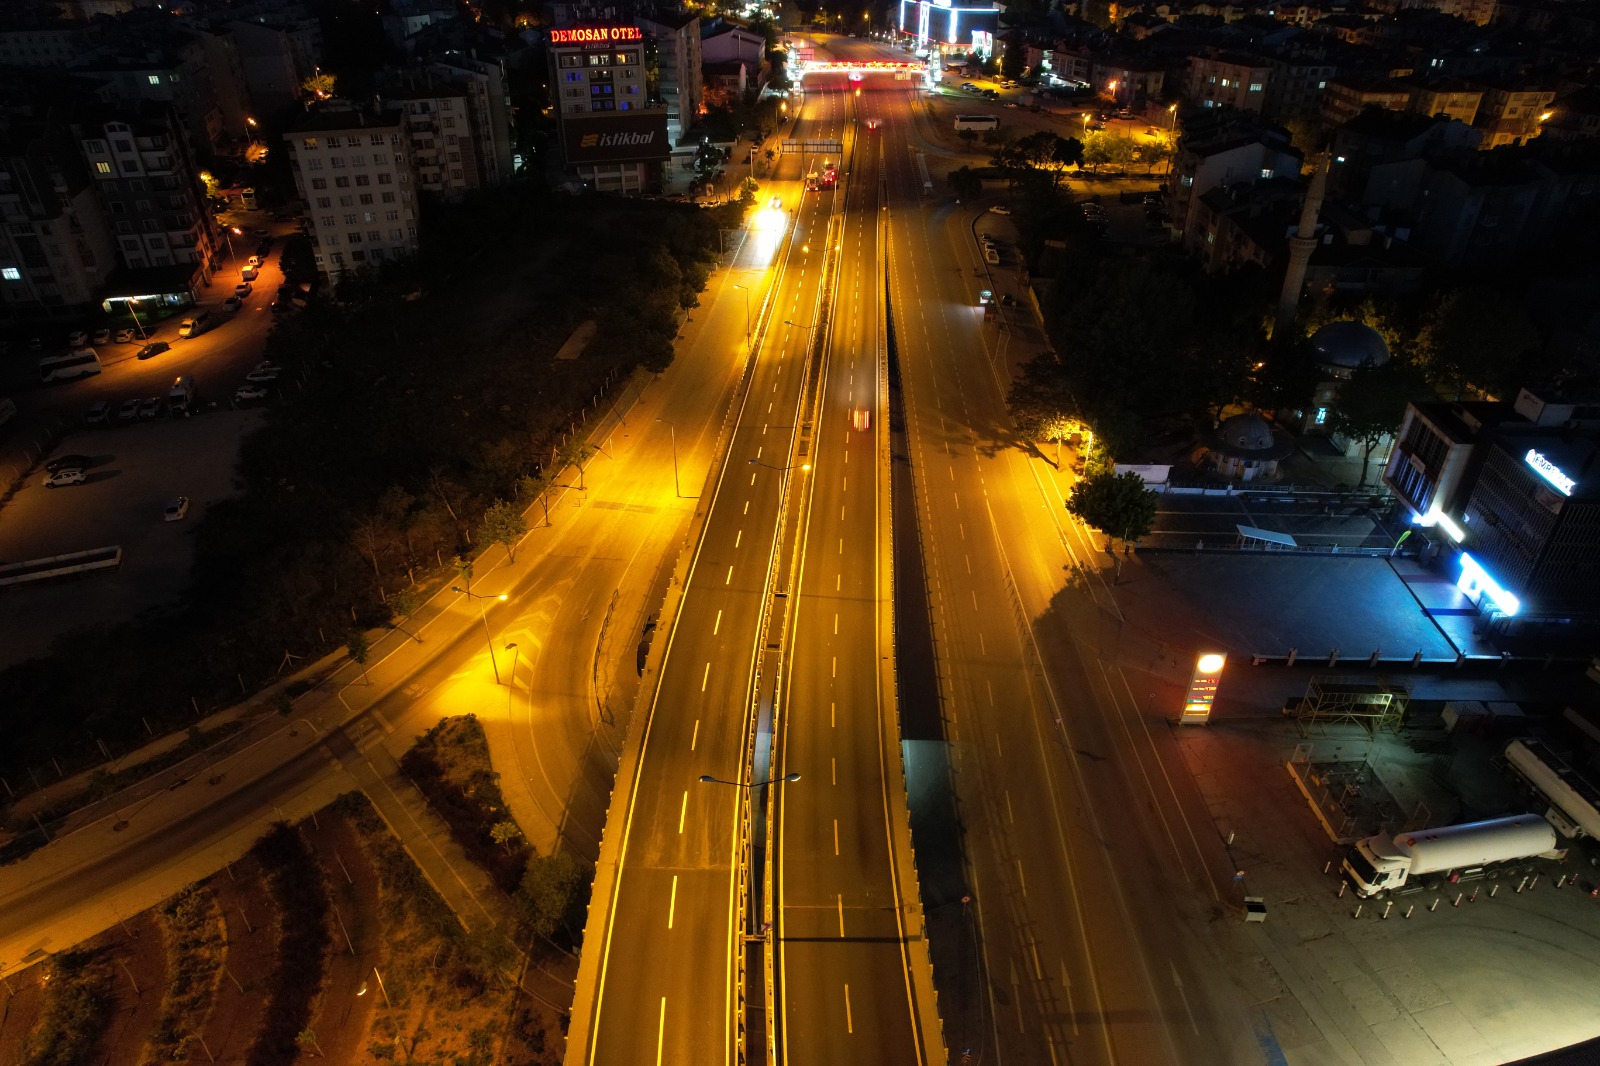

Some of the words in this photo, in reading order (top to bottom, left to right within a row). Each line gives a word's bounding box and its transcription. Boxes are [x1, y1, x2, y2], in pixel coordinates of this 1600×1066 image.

[551, 28, 608, 42] DEMOSAN
[611, 27, 642, 39] OTEL
[600, 131, 654, 146] istikbal
